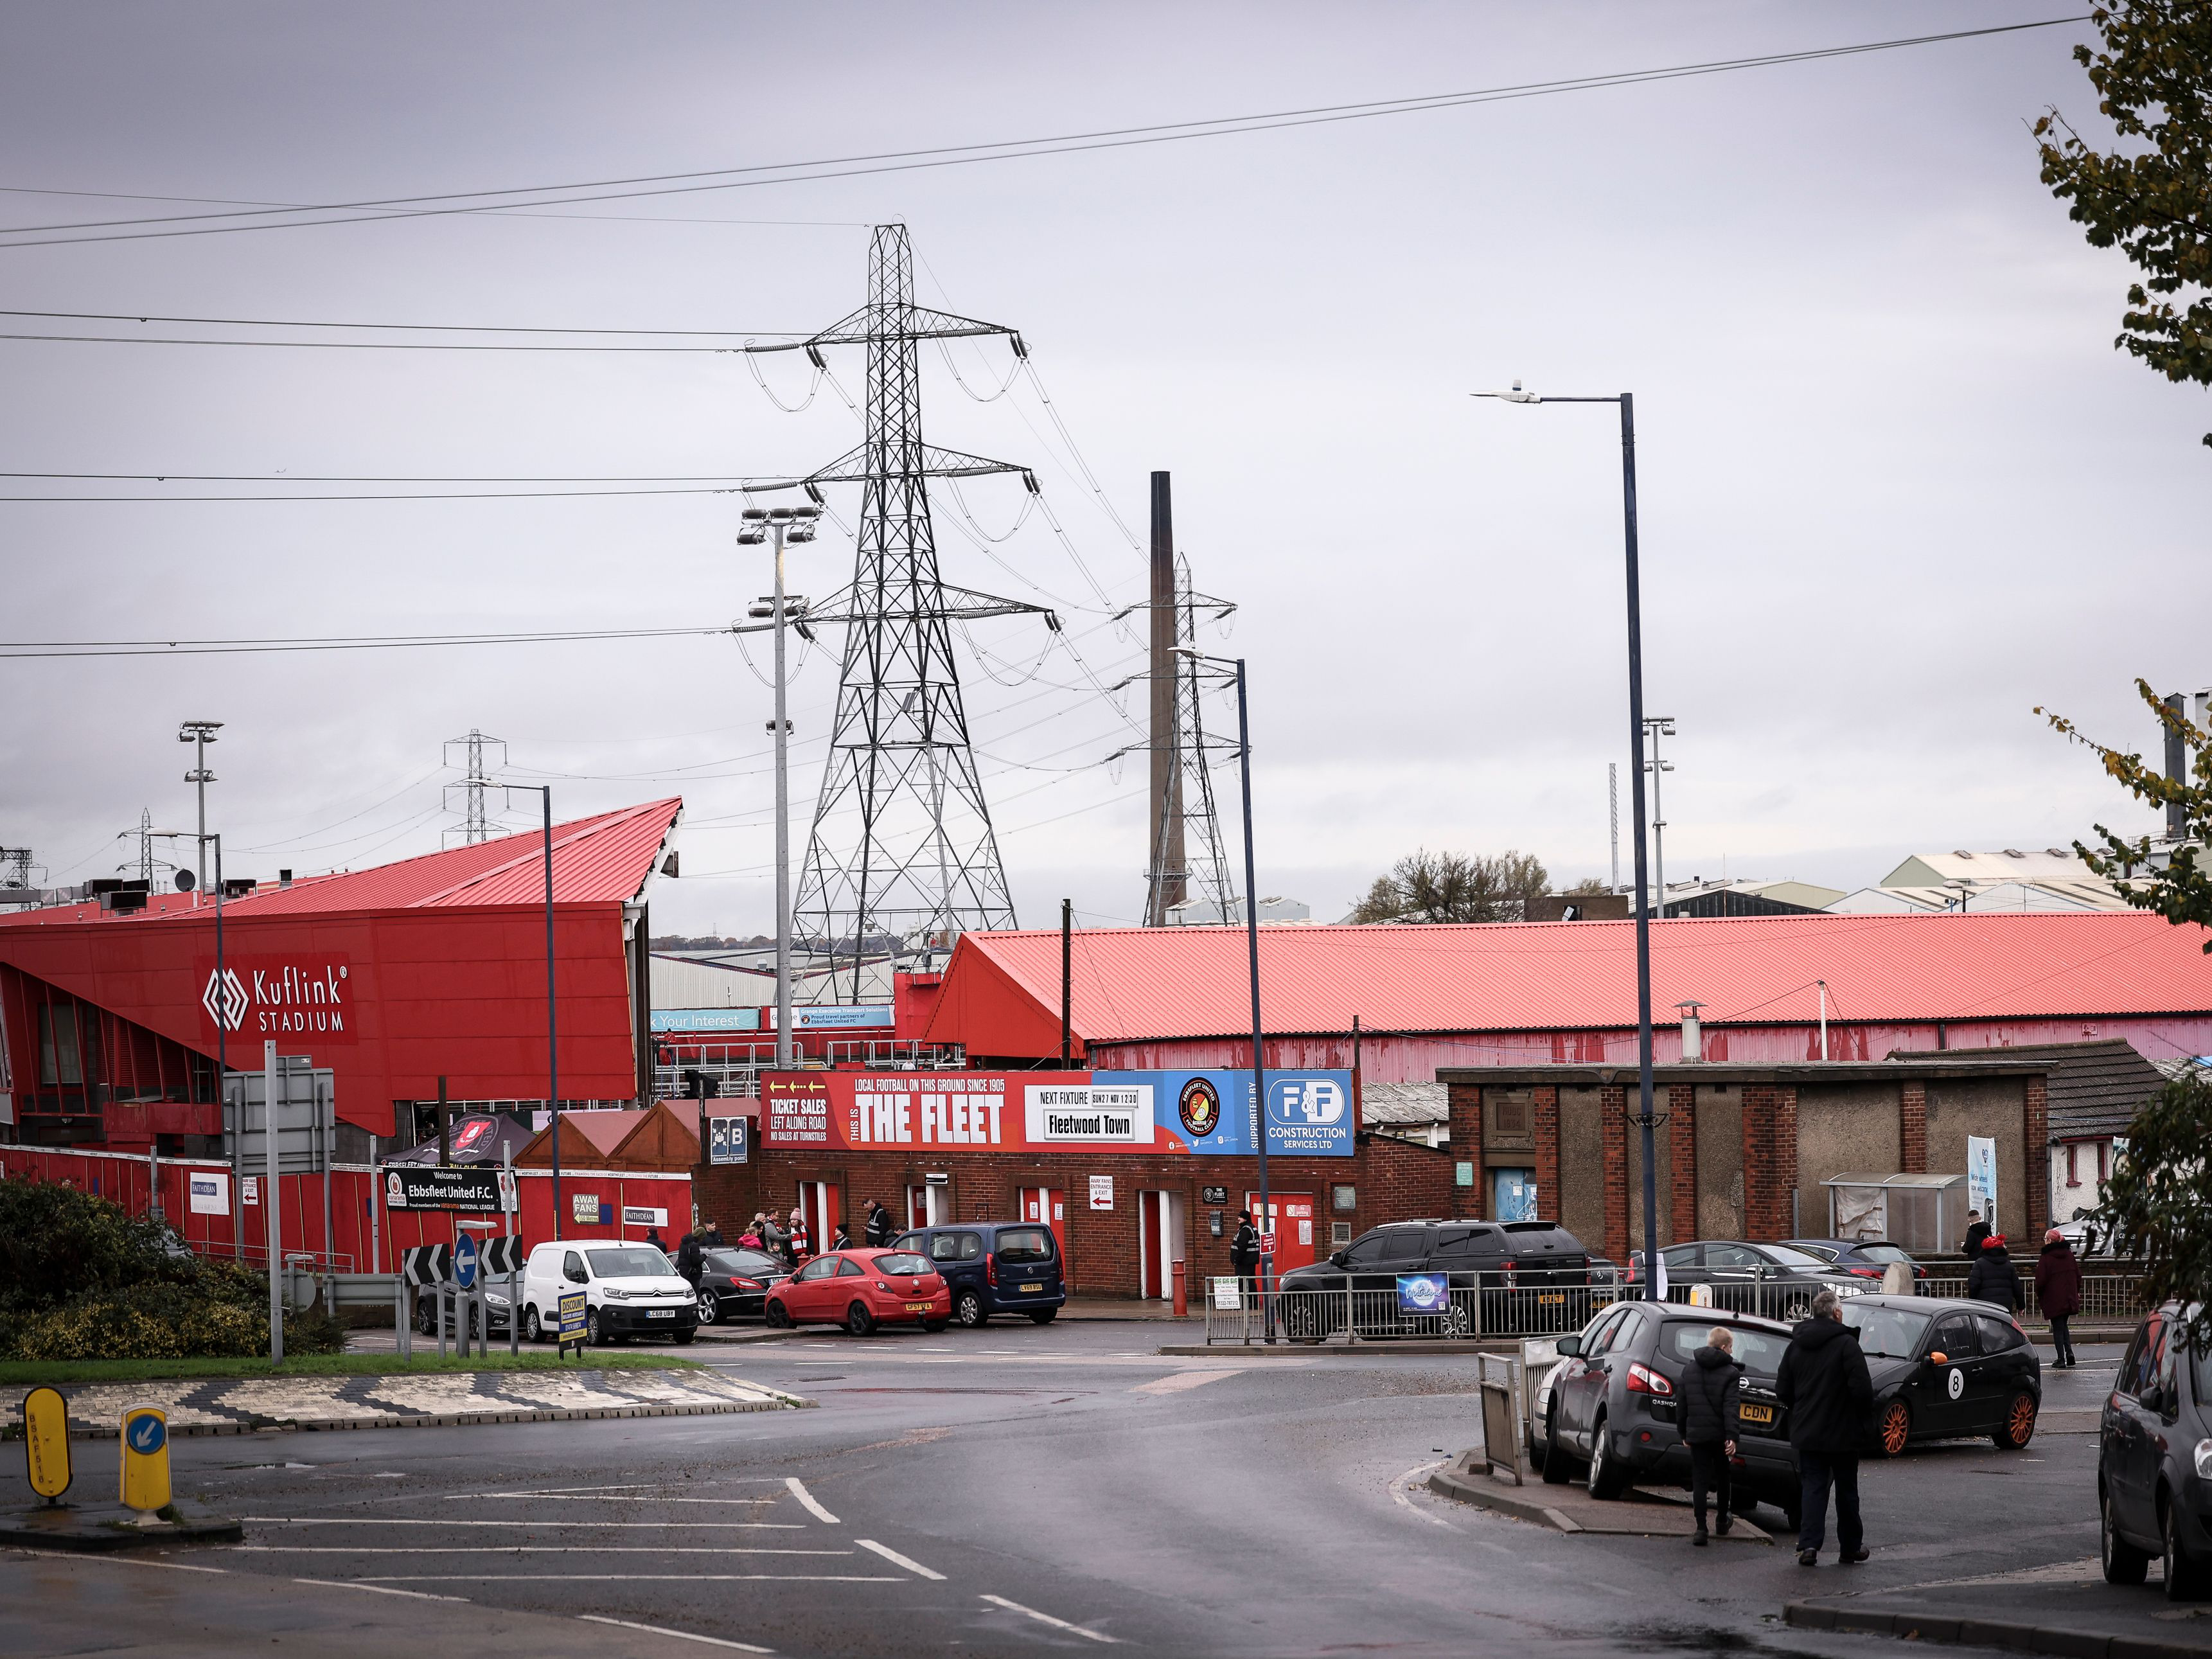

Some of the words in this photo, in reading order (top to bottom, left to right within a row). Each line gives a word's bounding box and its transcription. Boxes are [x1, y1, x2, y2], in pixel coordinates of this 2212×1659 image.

[259, 1011, 343, 1031] STADIUM
[660, 1015, 687, 1027] Your
[692, 1015, 739, 1026] Interest
[854, 1079, 874, 1092] LOCAL
[876, 1079, 908, 1092] FOOTBALL
[910, 1079, 919, 1092] ON
[921, 1079, 935, 1092] THIS
[937, 1079, 966, 1092] GROUND
[968, 1079, 987, 1092] SINCE
[989, 1079, 1004, 1092] 1905
[1183, 1083, 1201, 1101] EBBSFLEET
[1201, 1083, 1215, 1101] UNITED
[1249, 1082, 1257, 1094] BY
[1040, 1092, 1057, 1105] NEXT
[1060, 1092, 1088, 1105] FIXTURE
[1283, 1087, 1332, 1117] F&F
[770, 1099, 799, 1114] TICKET
[801, 1099, 826, 1114] SALES
[850, 1109, 858, 1117] IS
[771, 1116, 784, 1130] LEFT
[786, 1116, 807, 1130] ALONG
[809, 1116, 826, 1130] ROAD
[855, 1094, 912, 1142] THE
[921, 1094, 1004, 1144] FLEET
[1049, 1115, 1100, 1133] Fleetwood
[1104, 1115, 1129, 1133] Town
[1186, 1119, 1204, 1131] FOOTBALL
[1205, 1119, 1213, 1130] CLUB
[732, 1128, 743, 1144] B
[771, 1131, 777, 1141] NO
[779, 1131, 792, 1141] SALES
[793, 1131, 799, 1141] AT
[800, 1132, 826, 1141] TURNSTILES
[850, 1121, 859, 1141] THIS
[1269, 1128, 1346, 1138] CONSTRUCTION
[434, 1171, 456, 1180] Welcome
[409, 1185, 447, 1198] Ebbsfleet
[449, 1185, 475, 1199] United
[477, 1187, 493, 1199] F.C.
[574, 1196, 597, 1204] AWAY
[574, 1204, 597, 1212] FANS
[626, 1212, 653, 1220] FAITHDEAN
[1406, 1288, 1442, 1299] Winterland
[563, 1299, 583, 1311] DISCOUNT
[1953, 1376, 1959, 1392] 8
[1744, 1406, 1768, 1419] CDN
